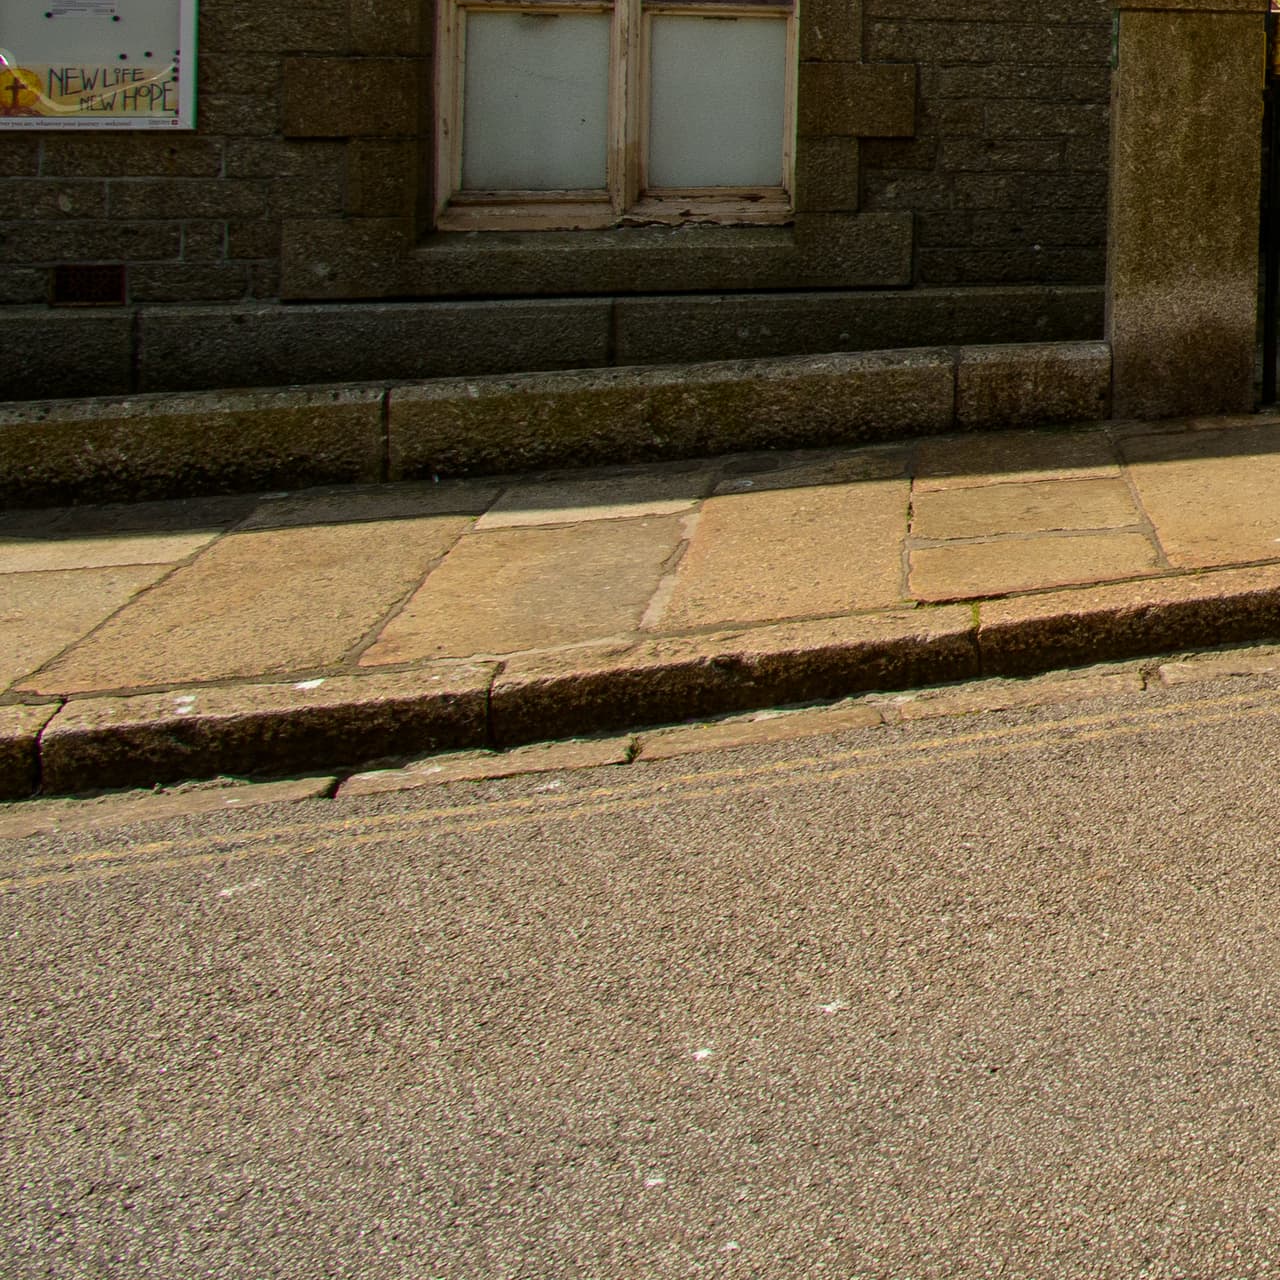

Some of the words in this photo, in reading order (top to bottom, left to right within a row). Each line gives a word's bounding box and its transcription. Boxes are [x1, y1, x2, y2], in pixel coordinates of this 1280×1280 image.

[48, 67, 100, 99] NEW
[80, 91, 117, 112] NEW
[123, 80, 176, 112] HOPE
